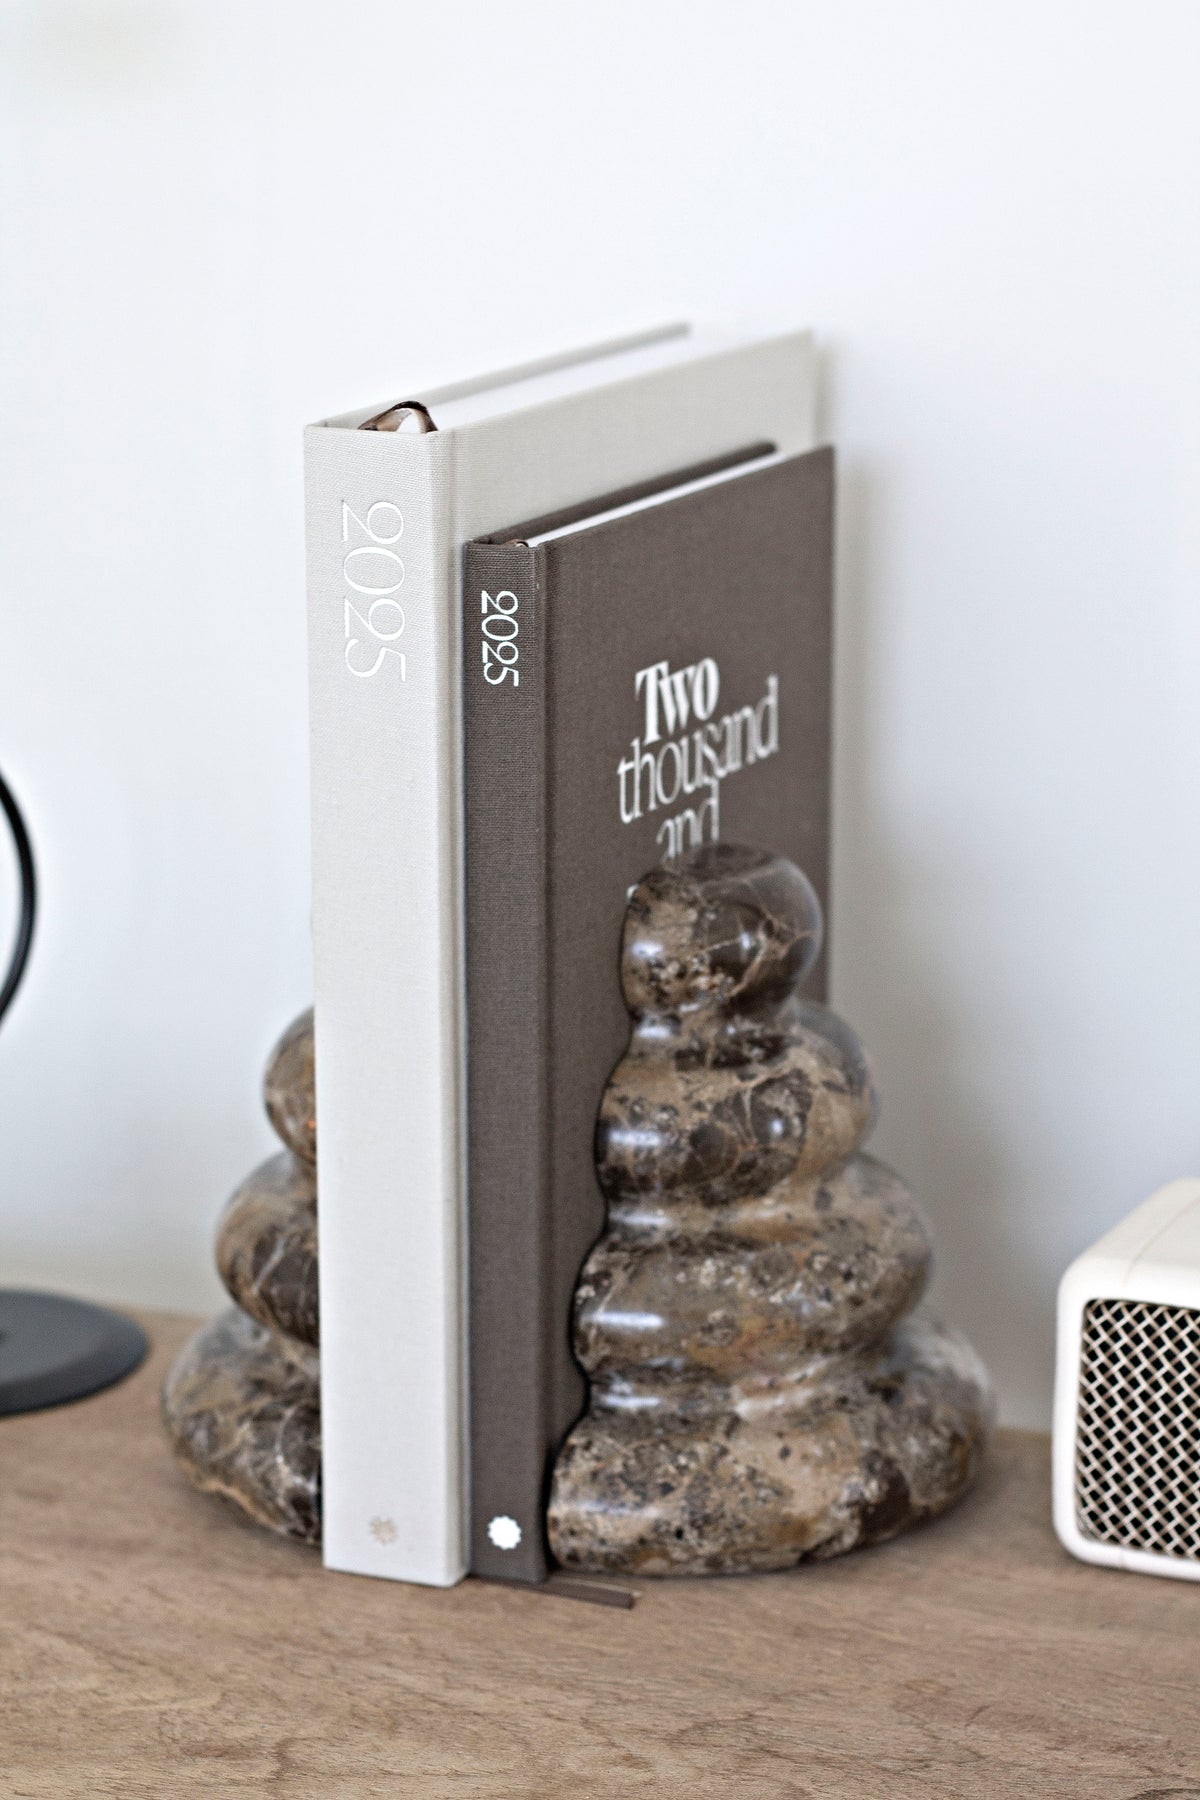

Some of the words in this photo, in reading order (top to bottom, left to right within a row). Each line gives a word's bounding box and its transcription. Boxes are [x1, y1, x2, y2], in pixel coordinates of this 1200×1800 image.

[343, 501, 406, 682] 2025
[481, 590, 519, 687] 2025
[617, 674, 779, 824] thousand
[635, 658, 720, 746] Two
